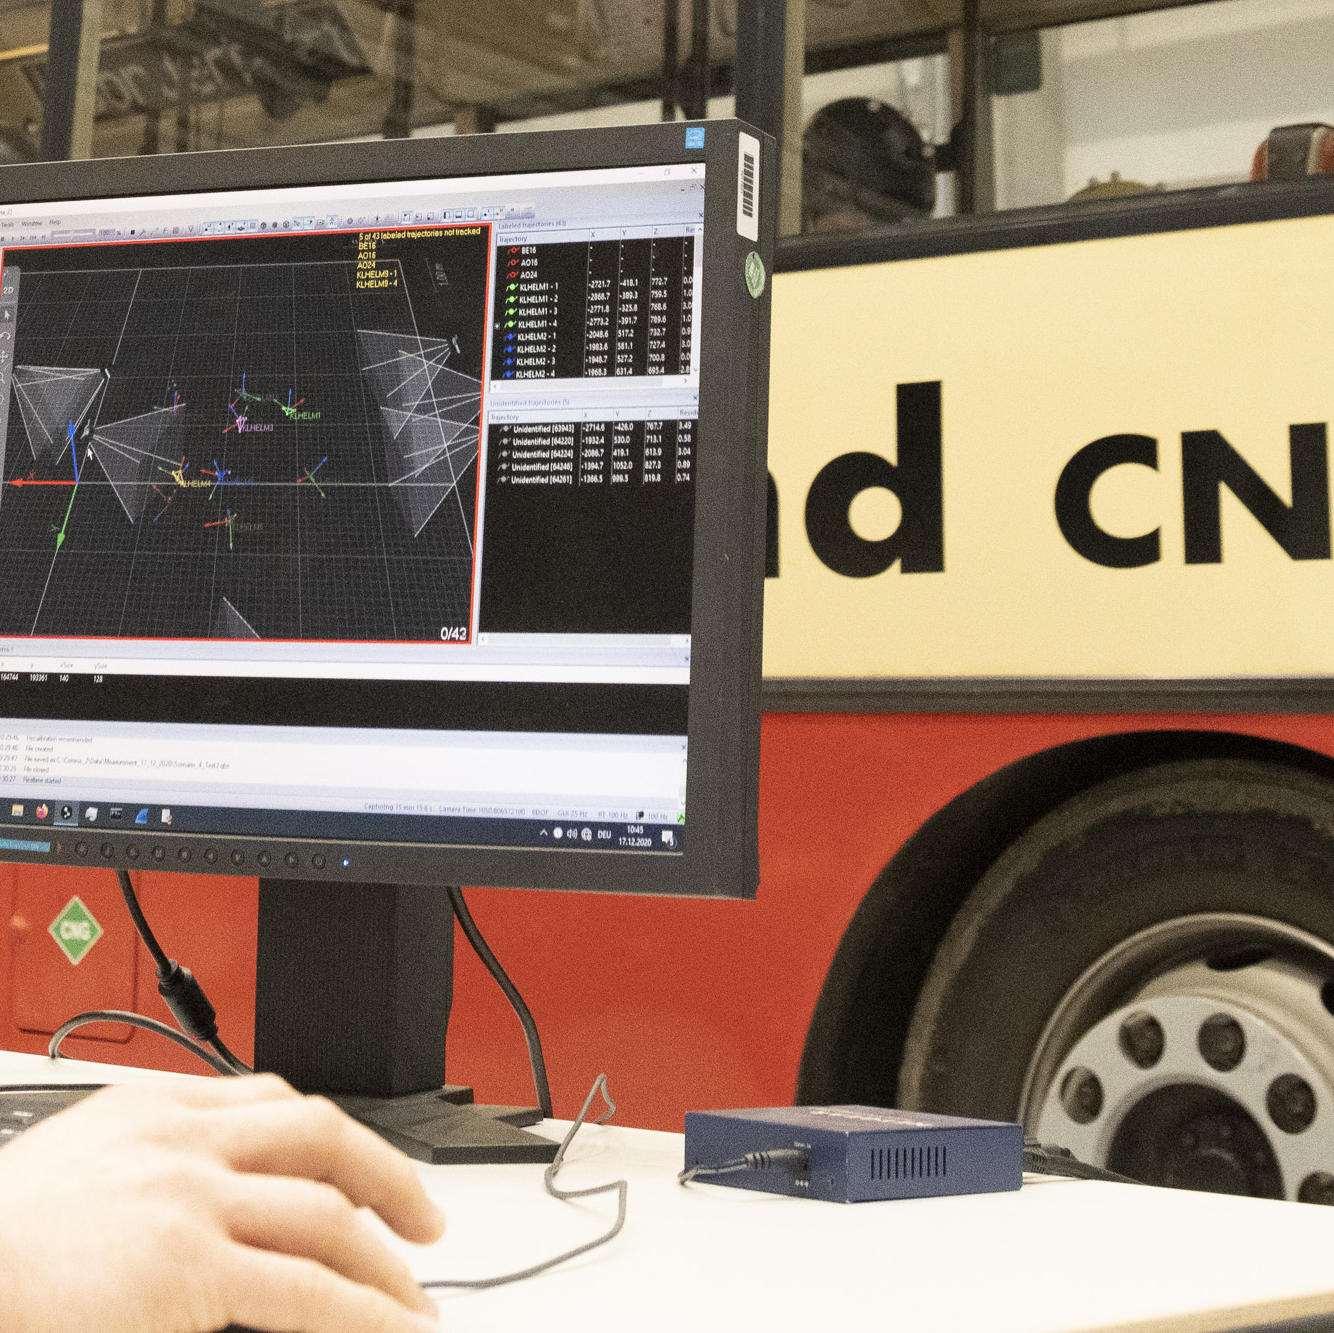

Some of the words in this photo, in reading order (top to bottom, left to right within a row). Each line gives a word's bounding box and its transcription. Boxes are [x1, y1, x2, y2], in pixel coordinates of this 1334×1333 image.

[381, 231, 405, 239] labeled
[407, 229, 443, 239] trajectories
[456, 227, 480, 235] tracked
[521, 246, 536, 254] BE16
[514, 425, 551, 433] Unidentified
[513, 437, 550, 446] Unidentified
[513, 450, 549, 458] Unidentified
[511, 462, 549, 471] Unidentified
[511, 475, 549, 484] Unidentified
[627, 825, 644, 834] 10:45
[598, 830, 611, 839] DEU
[619, 837, 652, 847] 17.12.2020
